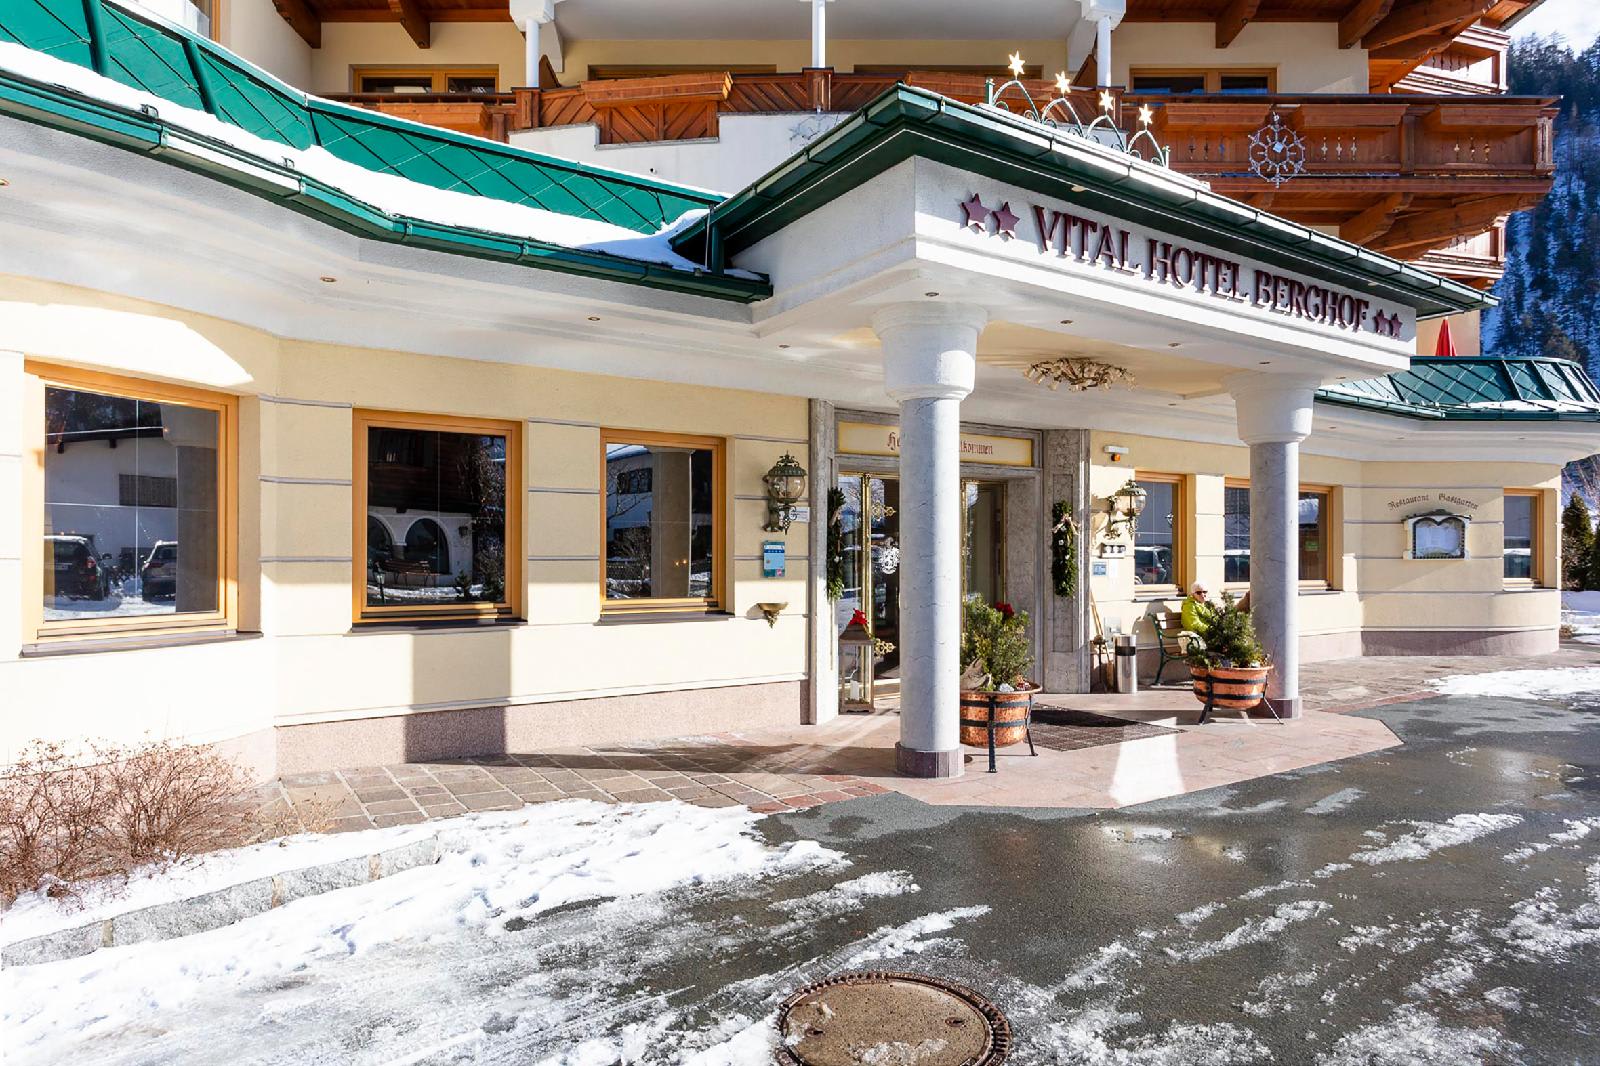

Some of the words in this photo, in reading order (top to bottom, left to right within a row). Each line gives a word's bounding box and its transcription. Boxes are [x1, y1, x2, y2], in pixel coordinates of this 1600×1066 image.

[1032, 205, 1139, 271] VITAL
[1146, 239, 1248, 299] HOTEL
[1254, 270, 1369, 331] BERGHOF
[1387, 495, 1429, 510] Restaurant
